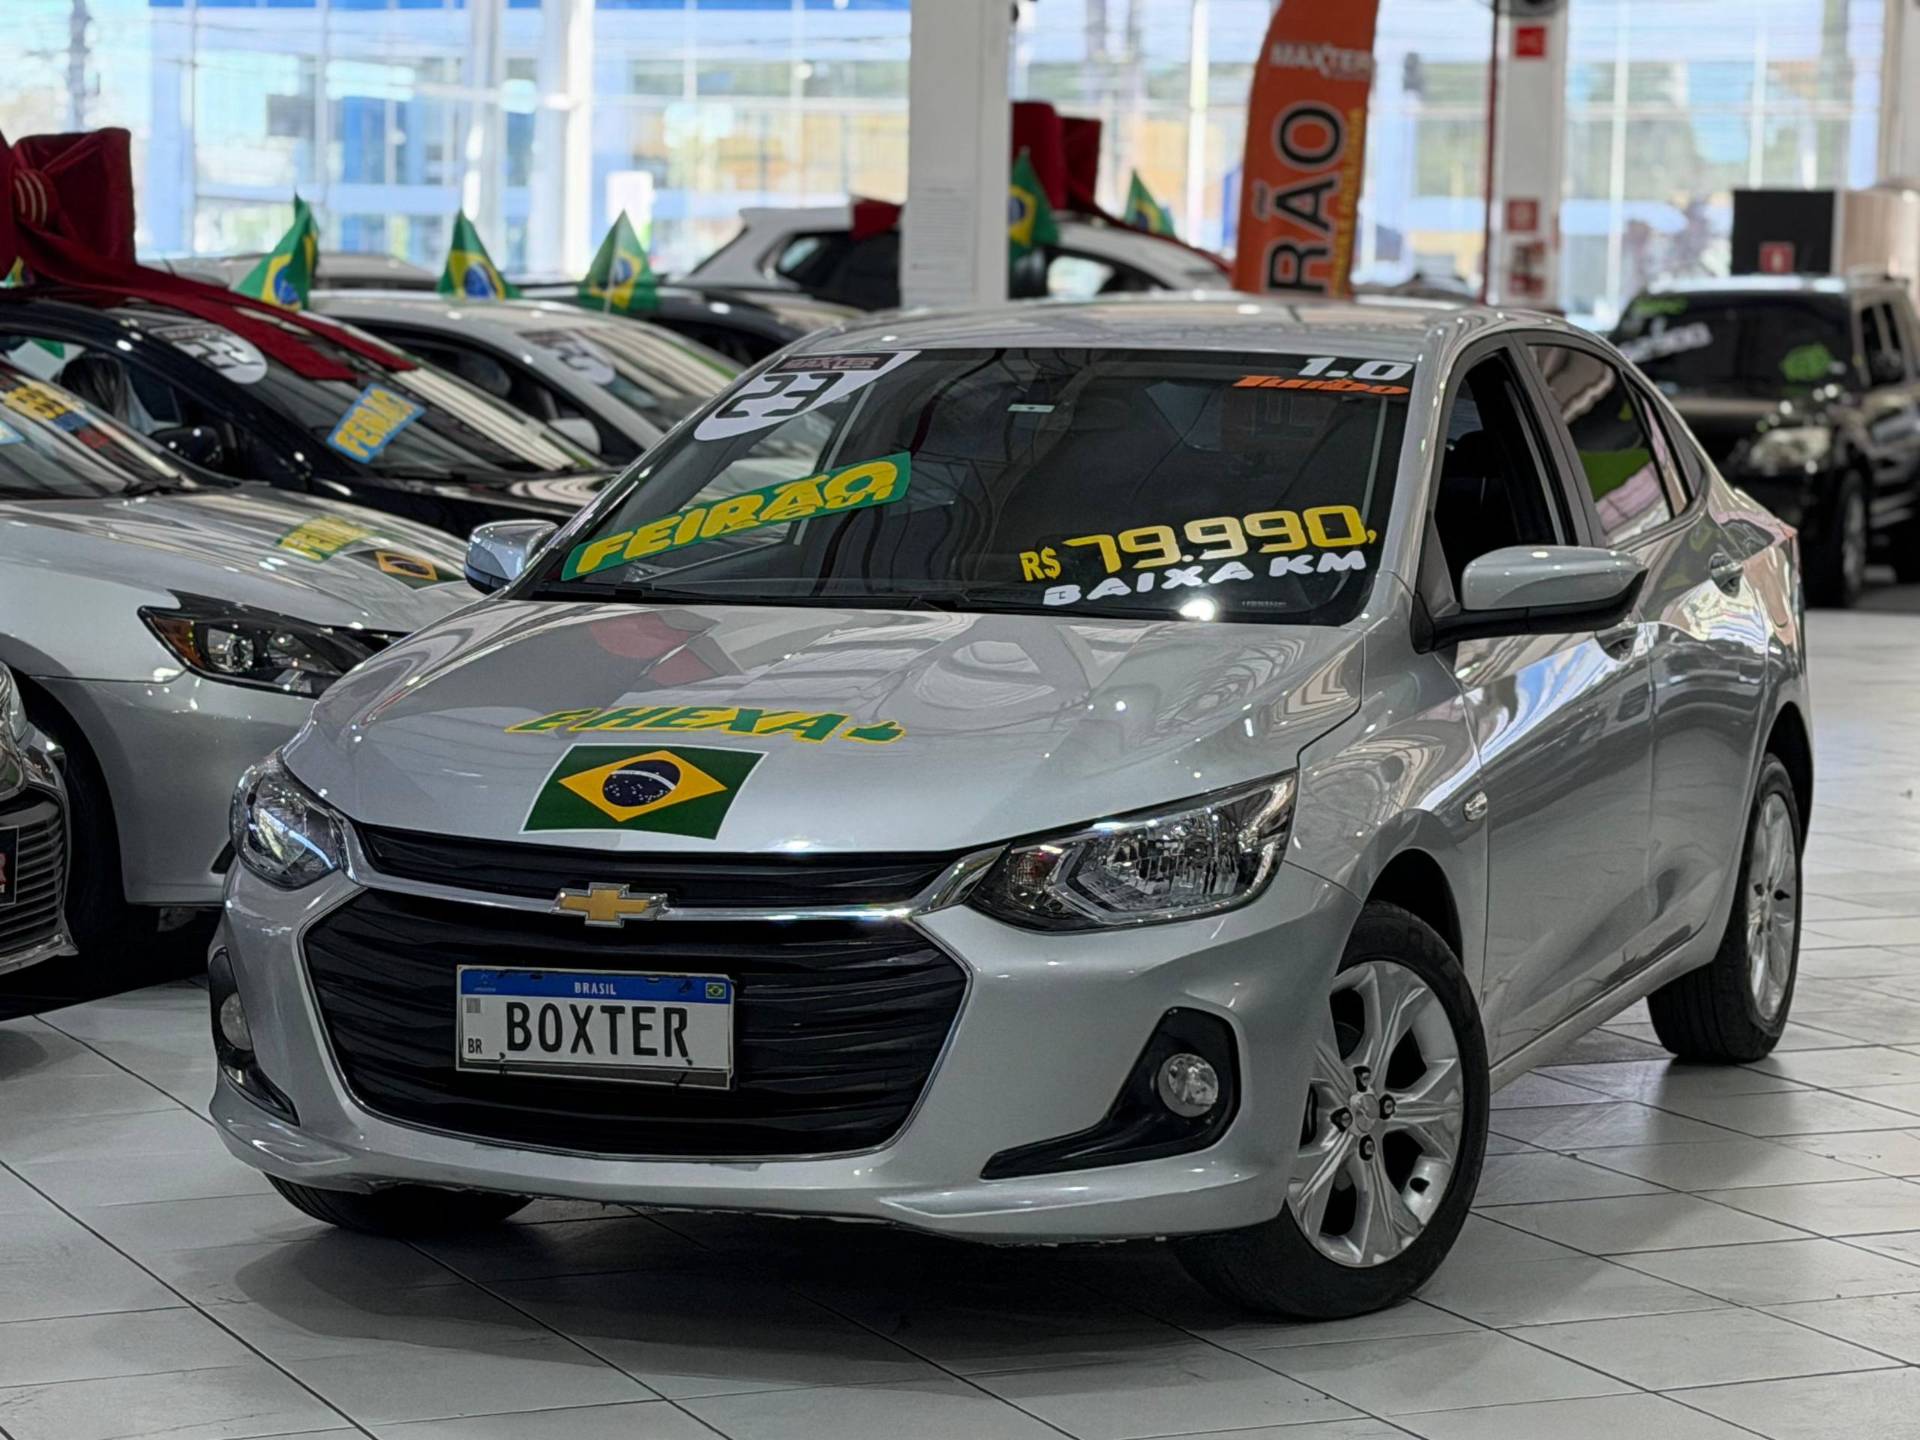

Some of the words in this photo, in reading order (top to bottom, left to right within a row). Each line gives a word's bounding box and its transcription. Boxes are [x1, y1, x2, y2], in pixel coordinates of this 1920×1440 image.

[1298, 357, 1413, 381] 1.0
[715, 372, 844, 419] 23
[575, 461, 898, 574] FEIRÃO
[1018, 546, 1062, 582] R$
[1042, 561, 1254, 606] BAIXA
[1269, 550, 1367, 577] KM
[568, 705, 850, 744] HEXA
[574, 981, 617, 996] BRASIL
[467, 1038, 483, 1055] BR
[506, 1002, 688, 1058] BOXTER
